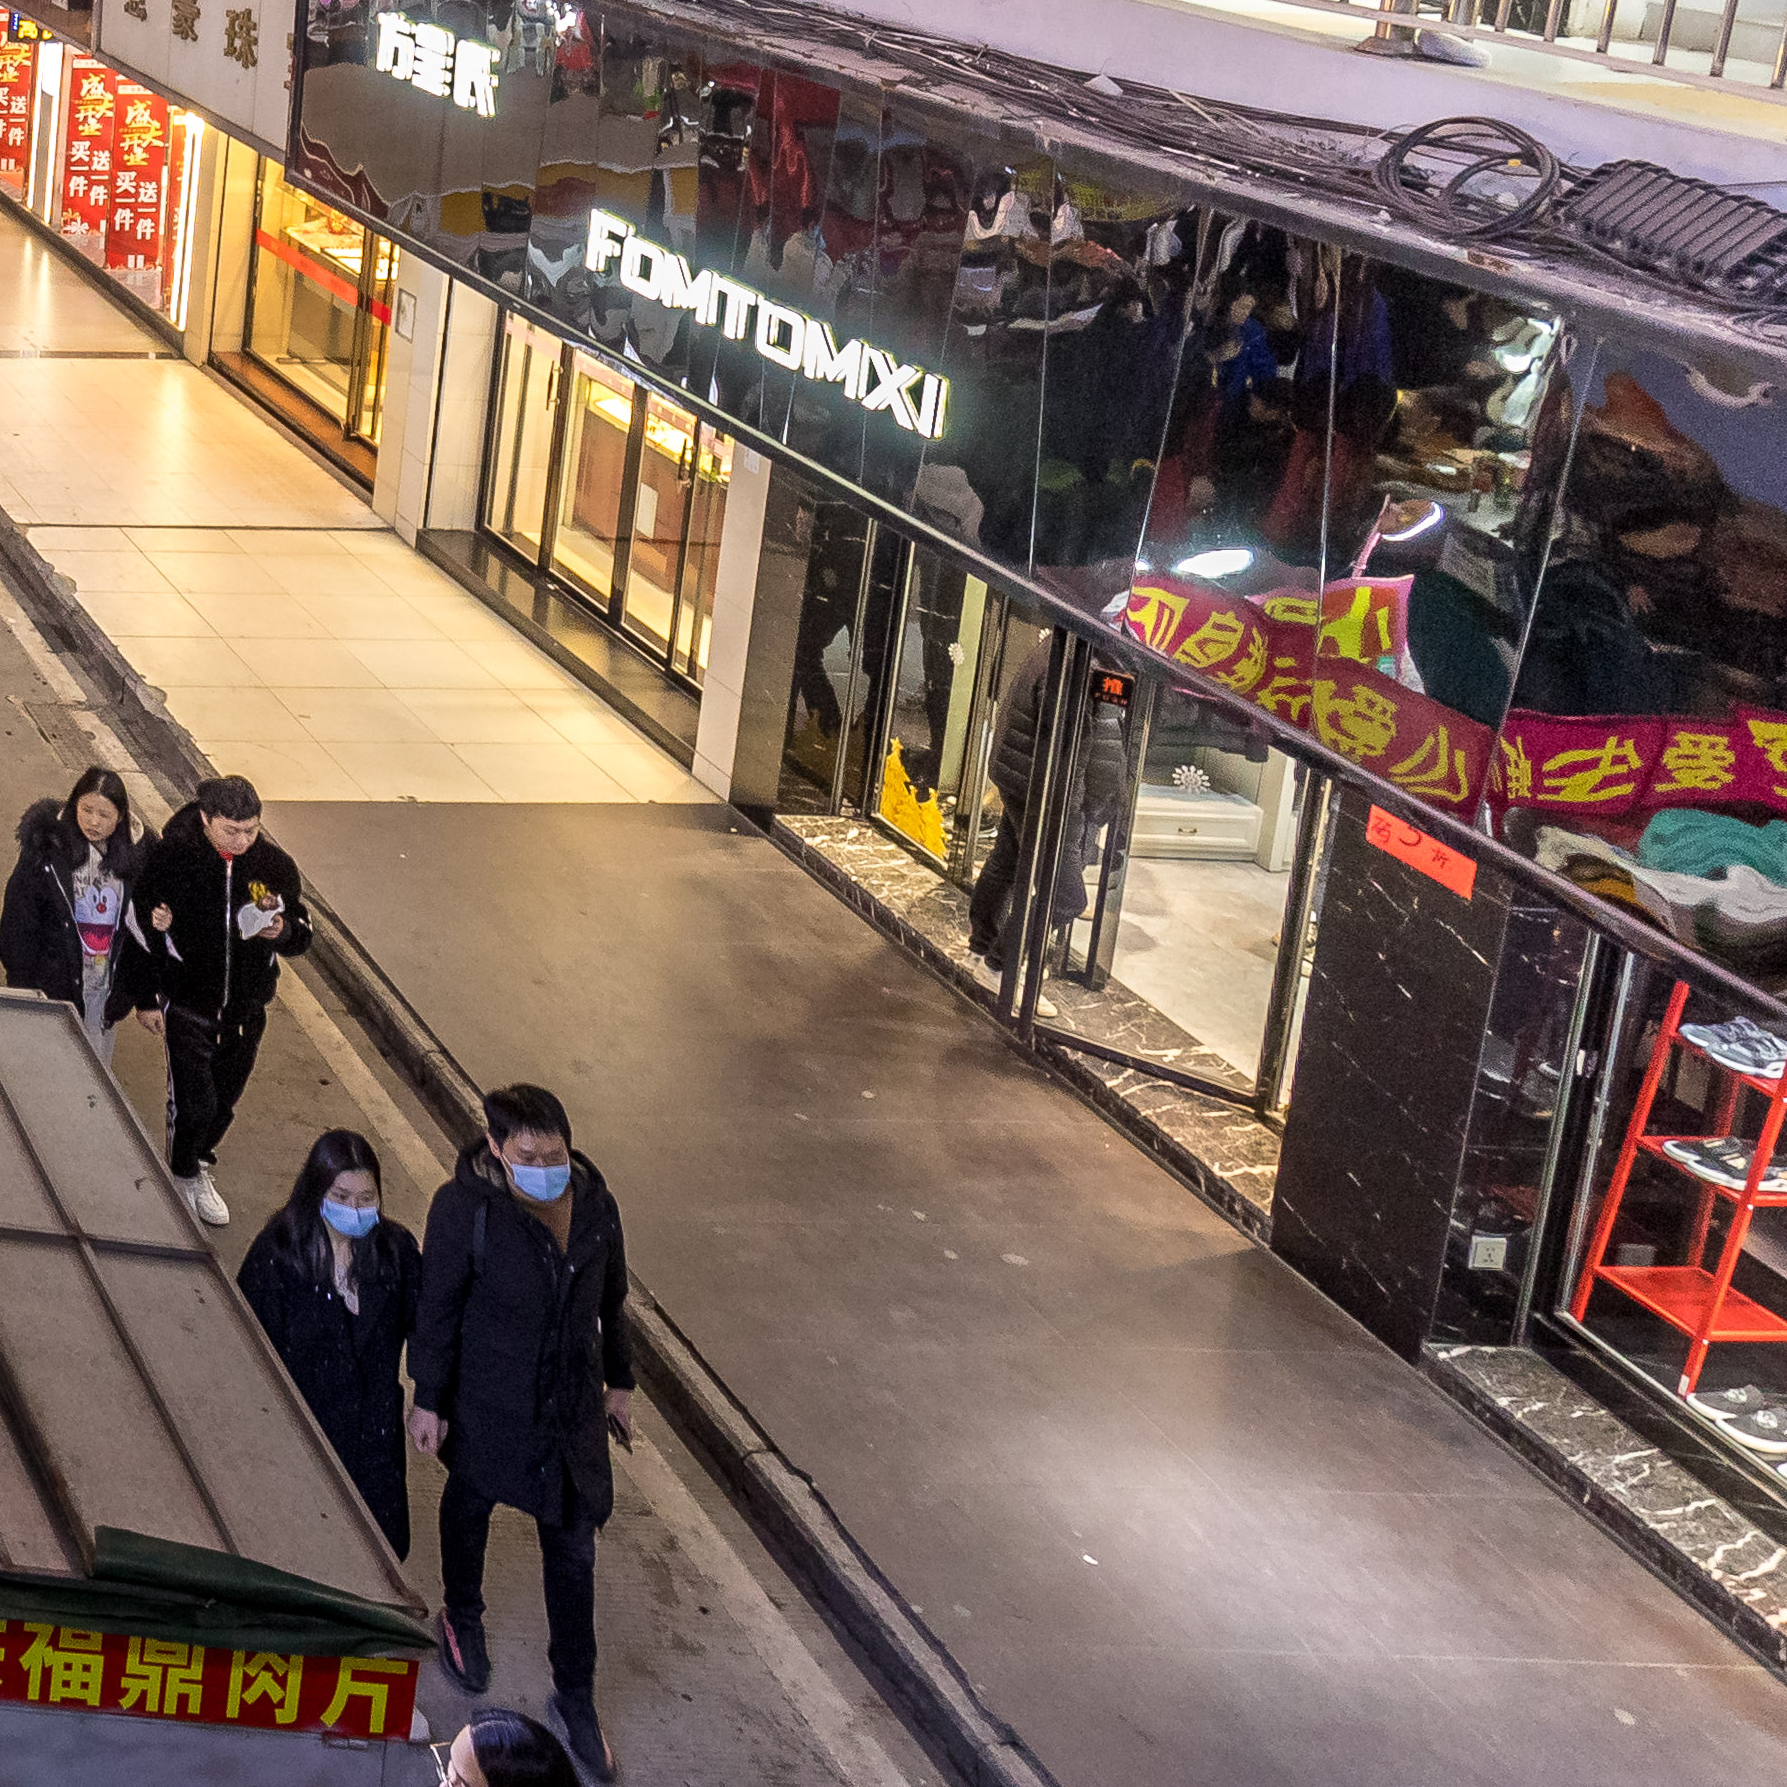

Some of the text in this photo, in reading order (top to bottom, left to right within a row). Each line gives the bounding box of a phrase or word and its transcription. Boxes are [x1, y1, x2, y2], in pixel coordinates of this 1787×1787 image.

[113, 170, 159, 241] 买一件 送一件
